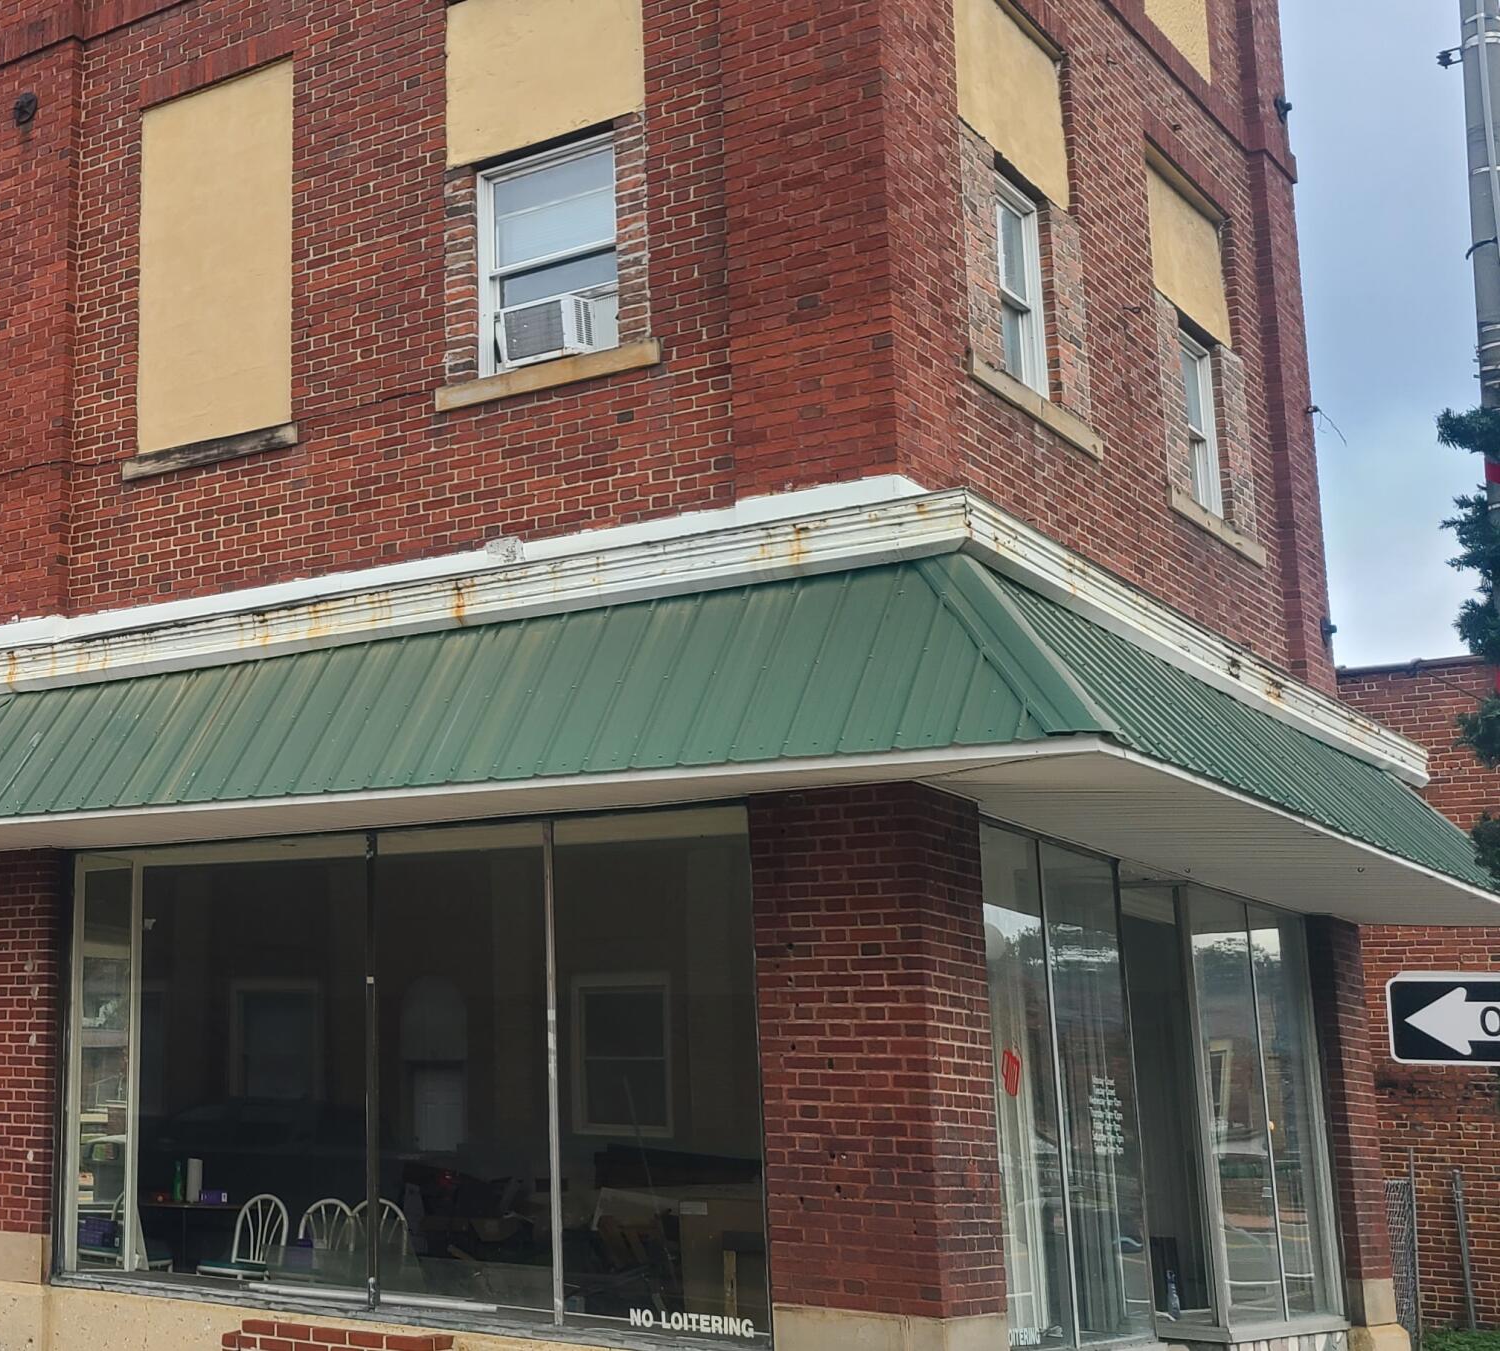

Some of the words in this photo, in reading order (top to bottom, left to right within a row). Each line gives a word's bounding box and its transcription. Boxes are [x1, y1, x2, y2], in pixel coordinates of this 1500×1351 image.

[629, 1308, 654, 1328] NO
[661, 1310, 754, 1338] LOITERING
[1008, 1327, 1041, 1346] OITERING
